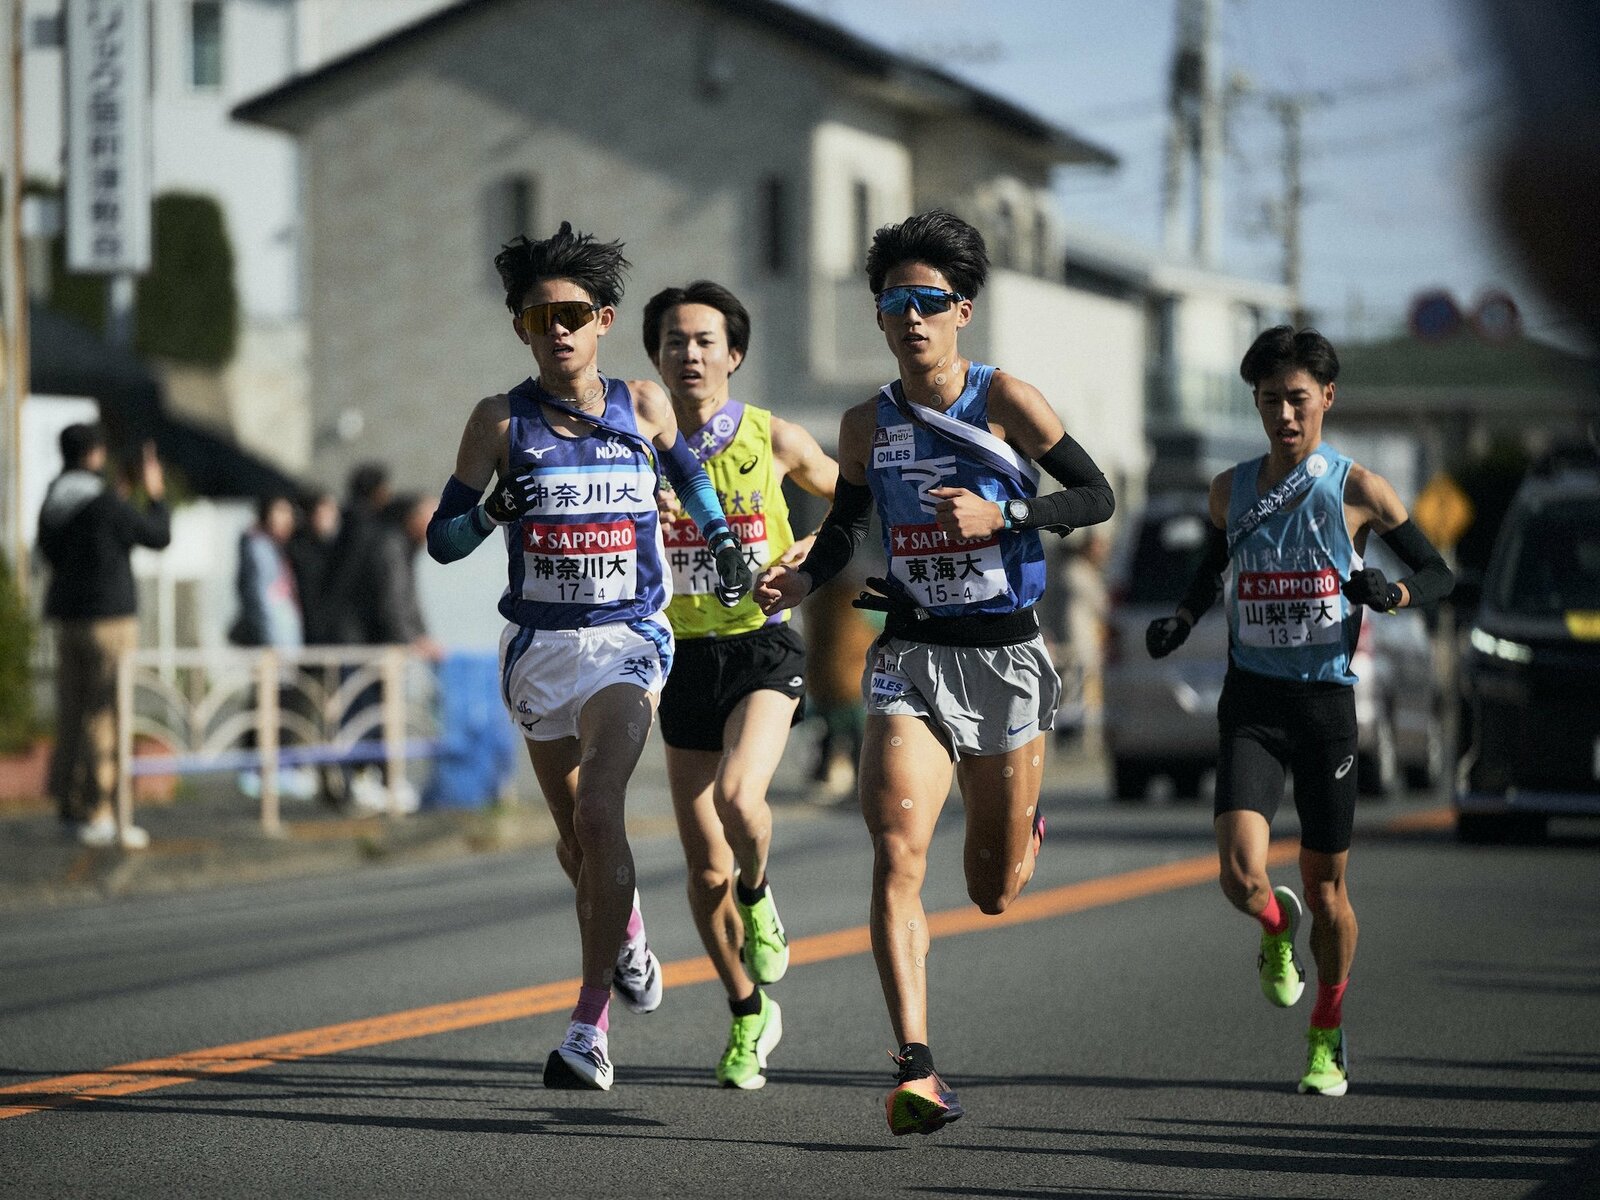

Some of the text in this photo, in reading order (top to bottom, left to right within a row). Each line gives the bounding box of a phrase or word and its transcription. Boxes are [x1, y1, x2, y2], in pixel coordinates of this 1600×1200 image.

[877, 449, 911, 463] OILES
[547, 527, 632, 549] SAPPORO
[533, 554, 627, 580] 神奈川大
[671, 546, 762, 573] 中央大
[905, 553, 984, 584] 東海大
[557, 583, 605, 601] 17-4
[925, 584, 973, 604] 15-4
[1258, 574, 1335, 596] SAPPORO
[1245, 600, 1333, 626] 山梨学大
[1268, 628, 1313, 645] 13-4
